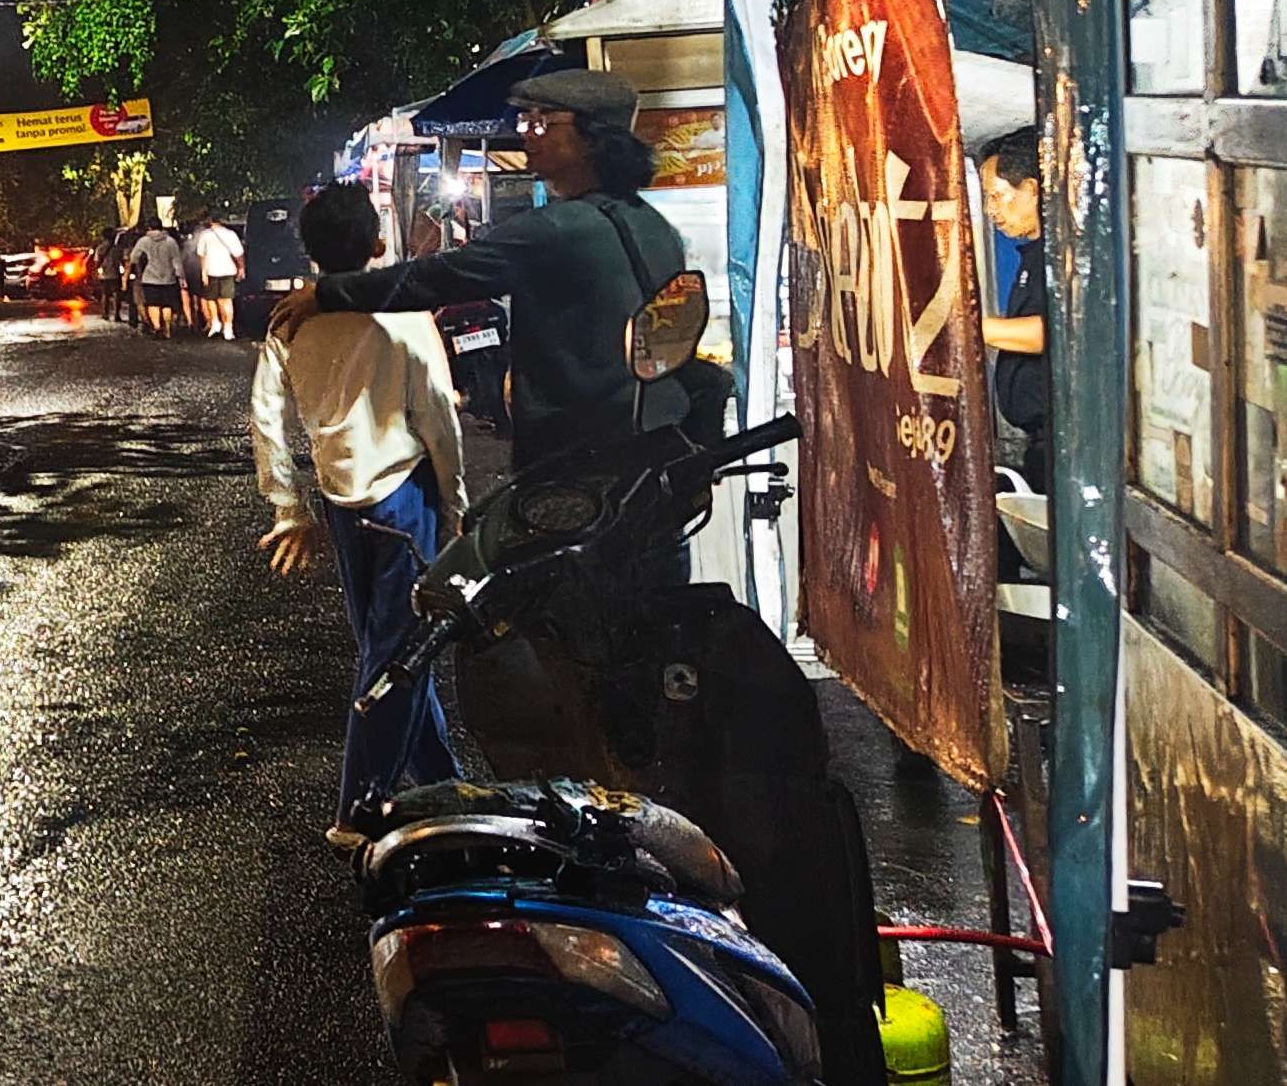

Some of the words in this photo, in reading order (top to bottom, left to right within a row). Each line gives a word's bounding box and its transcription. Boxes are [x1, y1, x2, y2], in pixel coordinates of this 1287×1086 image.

[15, 116, 52, 128] Hemat
[54, 114, 83, 125] terus
[15, 127, 46, 139] tanpa
